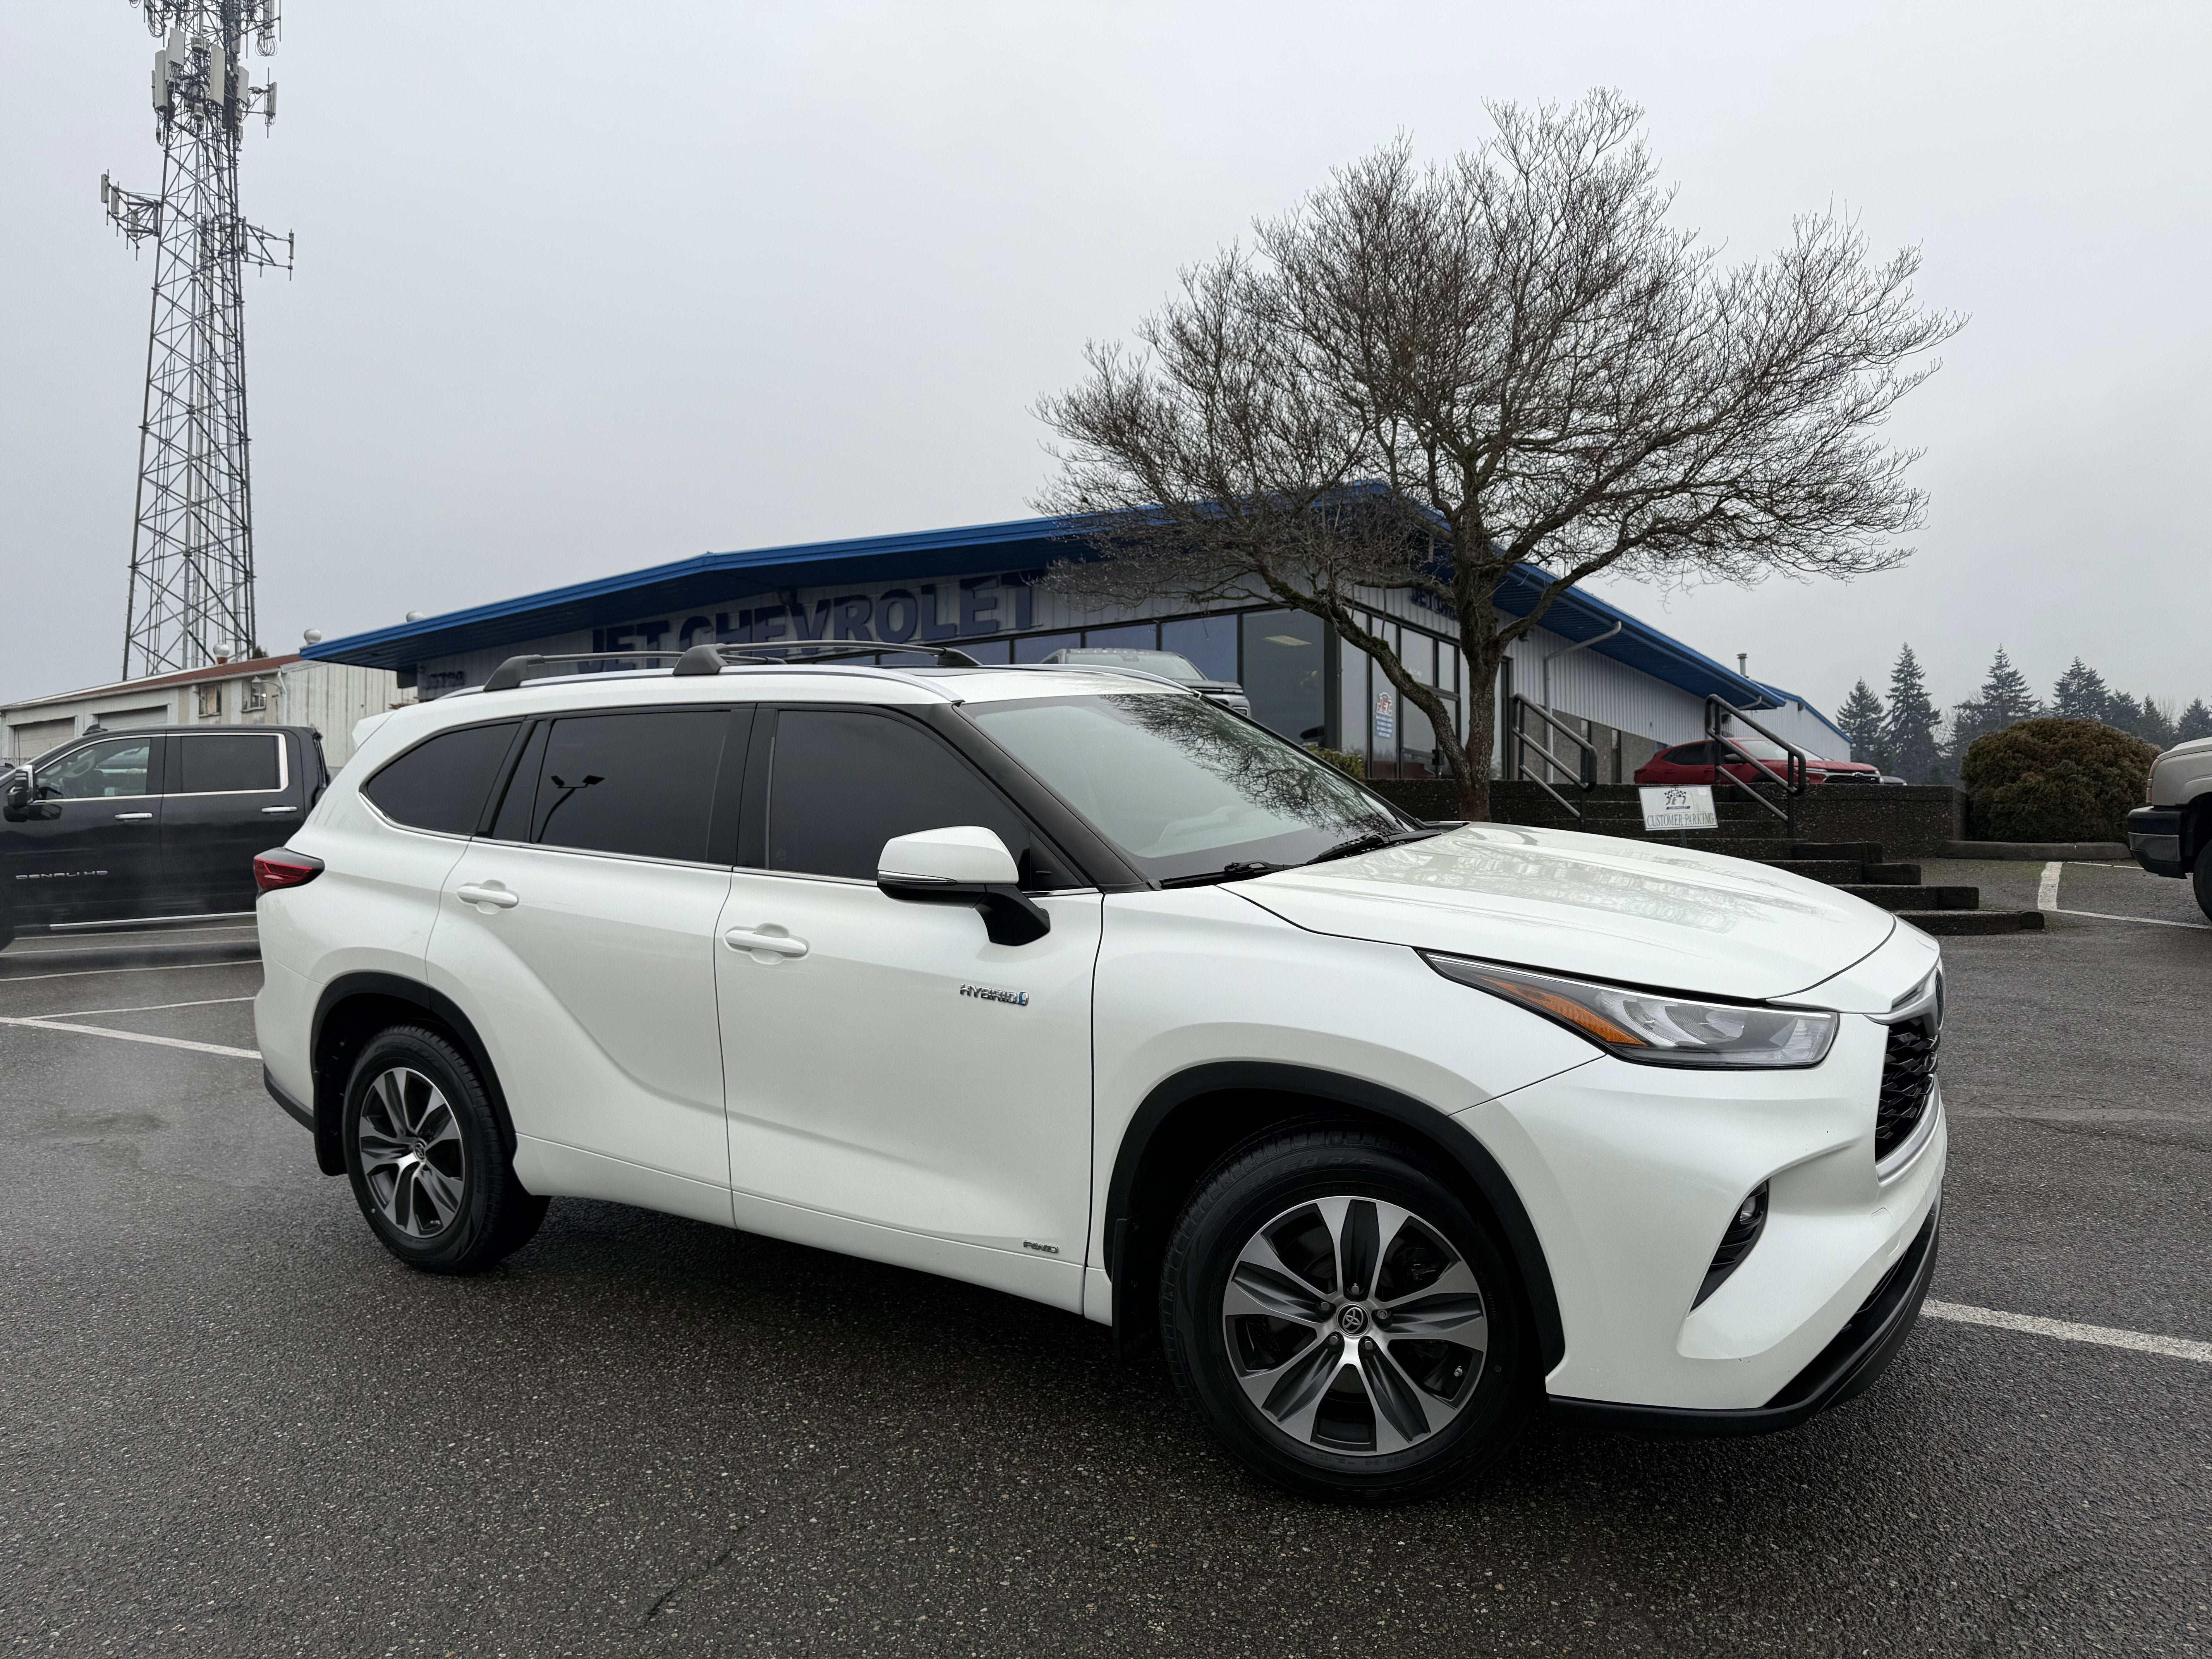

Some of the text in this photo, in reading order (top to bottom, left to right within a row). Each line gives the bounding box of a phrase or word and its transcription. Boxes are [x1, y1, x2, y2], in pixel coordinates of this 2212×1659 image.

[577, 568, 1046, 674] JET CHEVROLET
[1647, 812, 1714, 827] CUSTOMER PARKING
[960, 983, 1018, 1005] HYBRID
